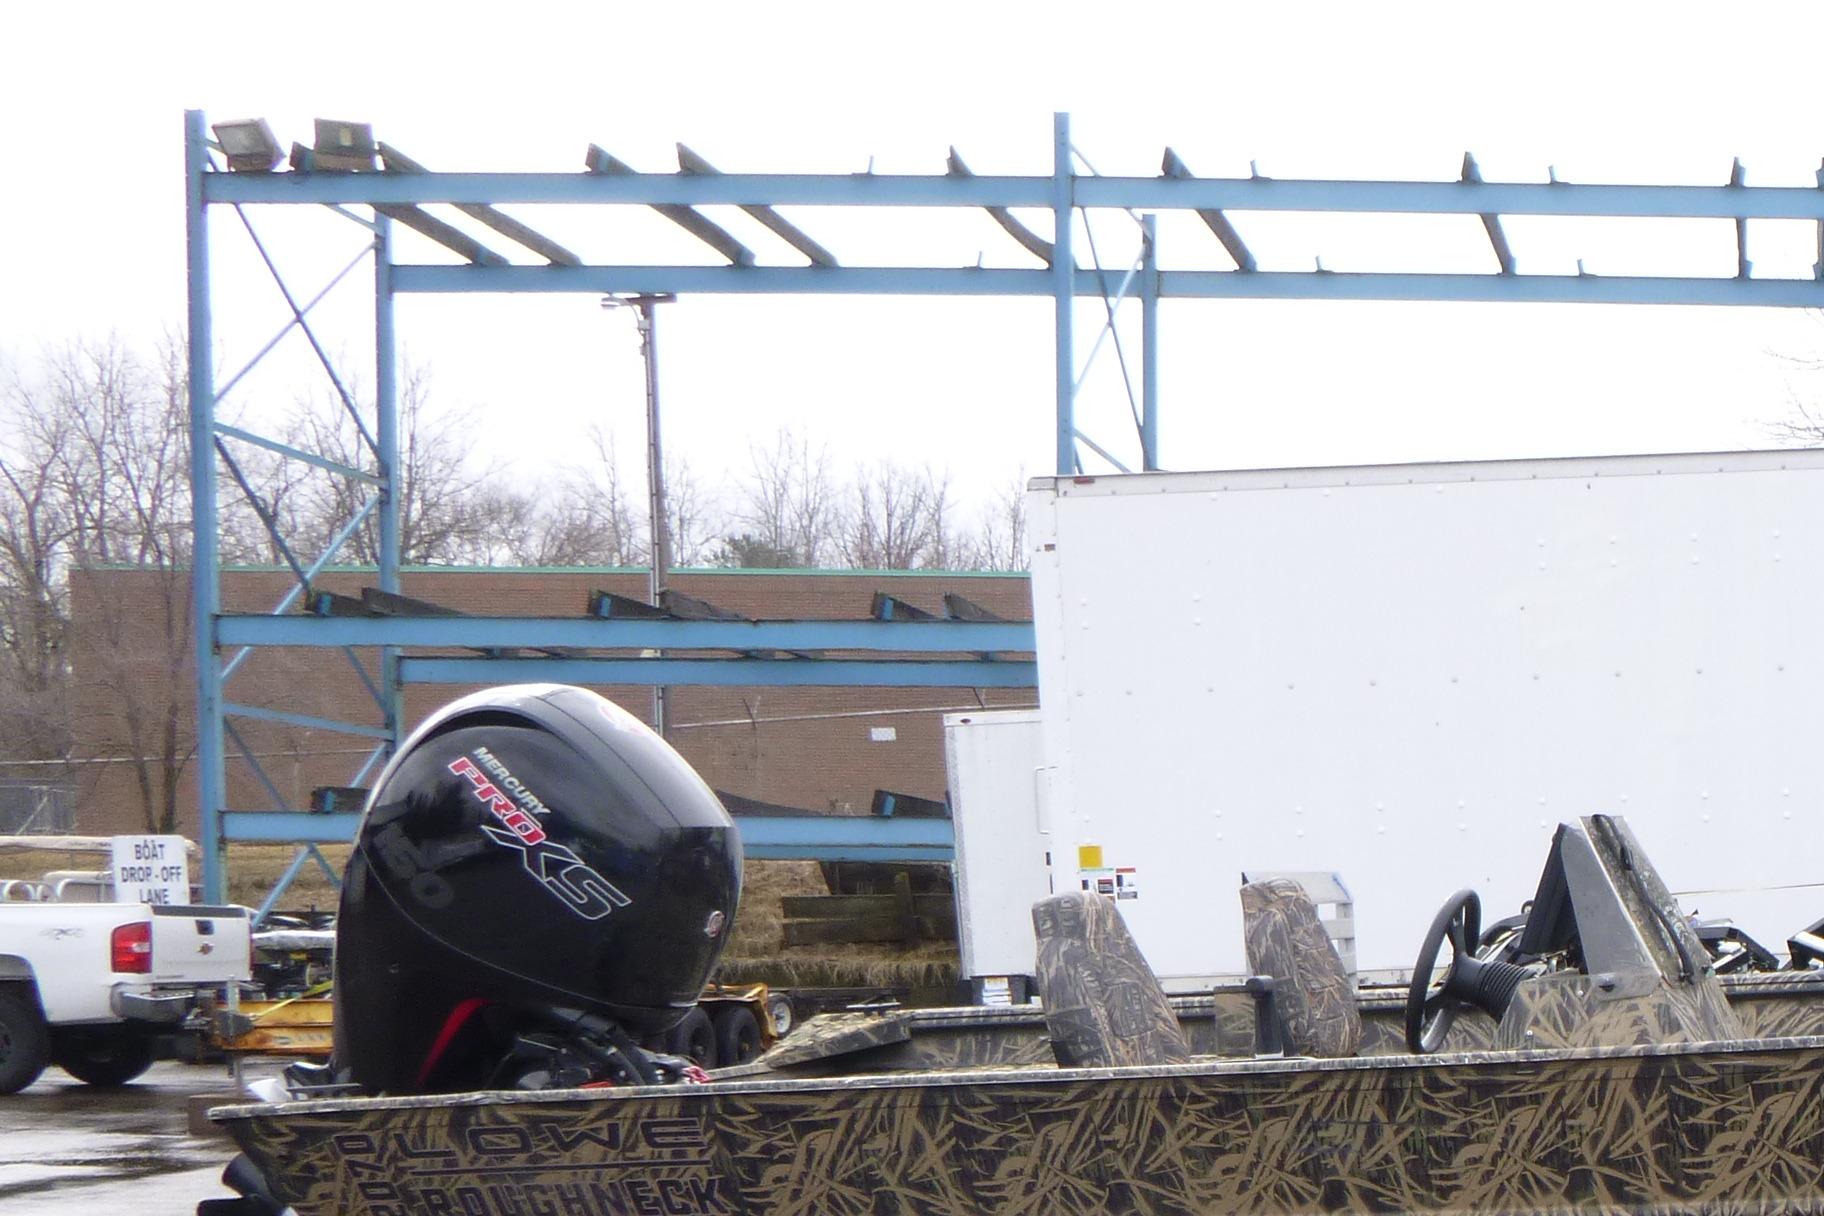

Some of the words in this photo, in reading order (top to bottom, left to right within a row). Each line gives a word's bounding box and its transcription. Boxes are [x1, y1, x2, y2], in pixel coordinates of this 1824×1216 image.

[448, 756, 546, 846] PRO
[472, 747, 551, 814] MERCURY
[134, 843, 165, 860] BOAT
[481, 824, 632, 920] XS
[139, 888, 170, 904] LANE
[394, 1117, 710, 1160] LOWE
